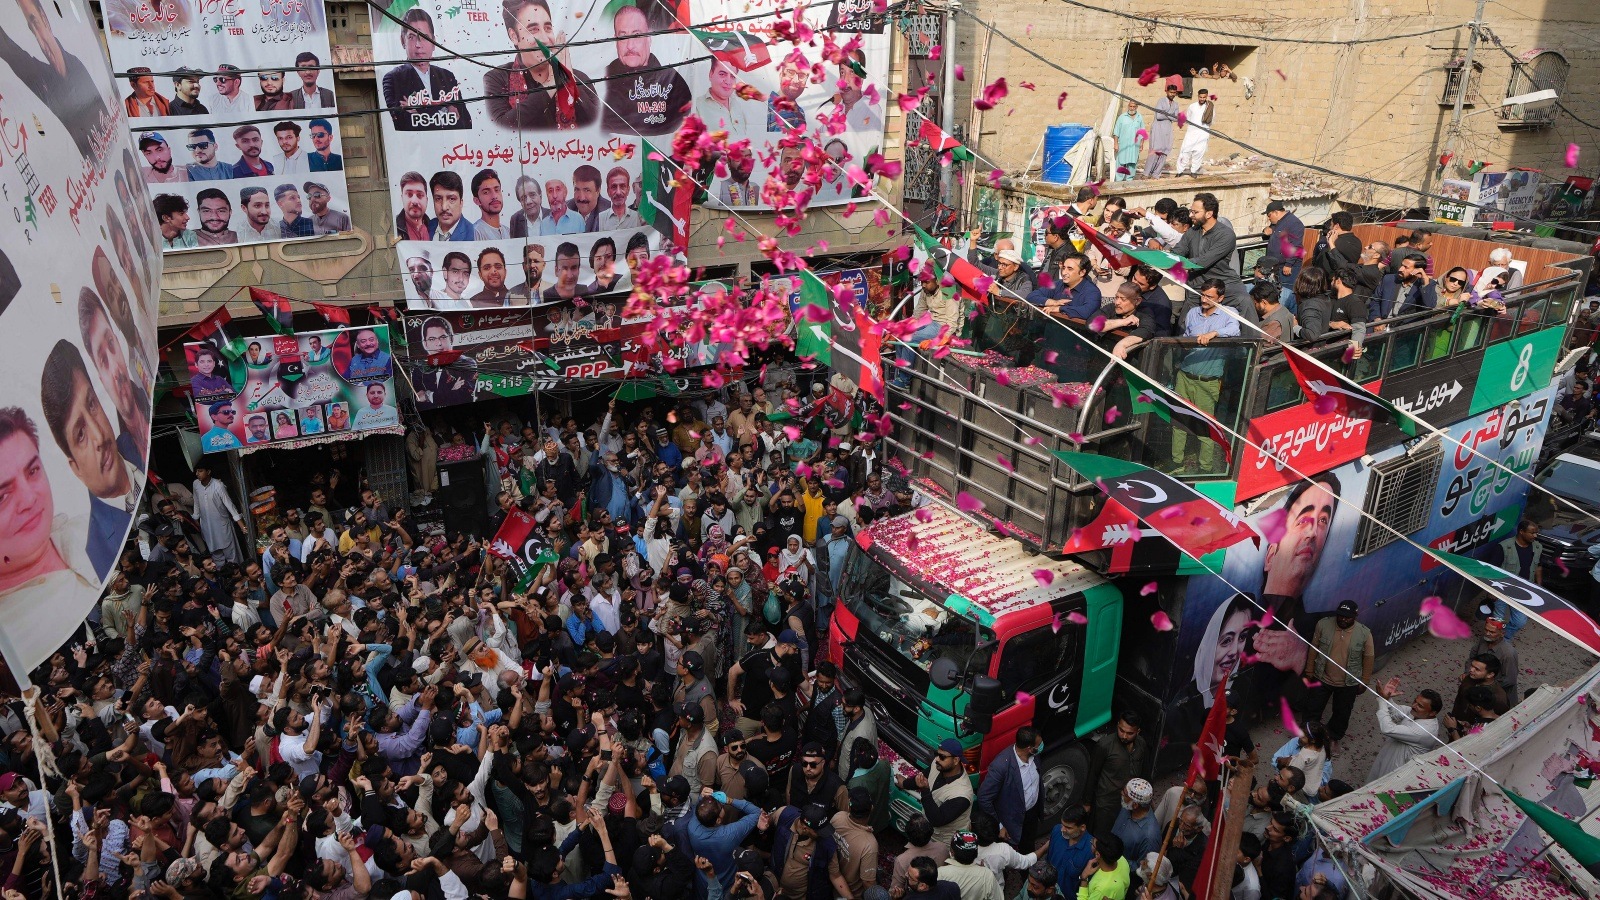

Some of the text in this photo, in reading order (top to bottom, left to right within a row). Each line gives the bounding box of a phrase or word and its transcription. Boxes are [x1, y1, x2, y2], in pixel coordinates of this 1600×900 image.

[130, 3, 178, 23] خالد شاہ
[467, 11, 490, 22] TEER
[228, 28, 245, 36] TEER
[411, 113, 458, 127] PS-115
[442, 137, 636, 168] ولکم ویلکم بلاول بھٹو ویلکم
[38, 184, 58, 218] TEER
[1438, 203, 1466, 214] AGENCY
[478, 314, 501, 327] عوام
[565, 361, 609, 383] PPP
[1511, 343, 1533, 391] 8
[477, 380, 493, 392] PS
[1256, 434, 1282, 469] کو
[1275, 421, 1319, 472] سوچ
[1441, 446, 1535, 517] سوچ کو
